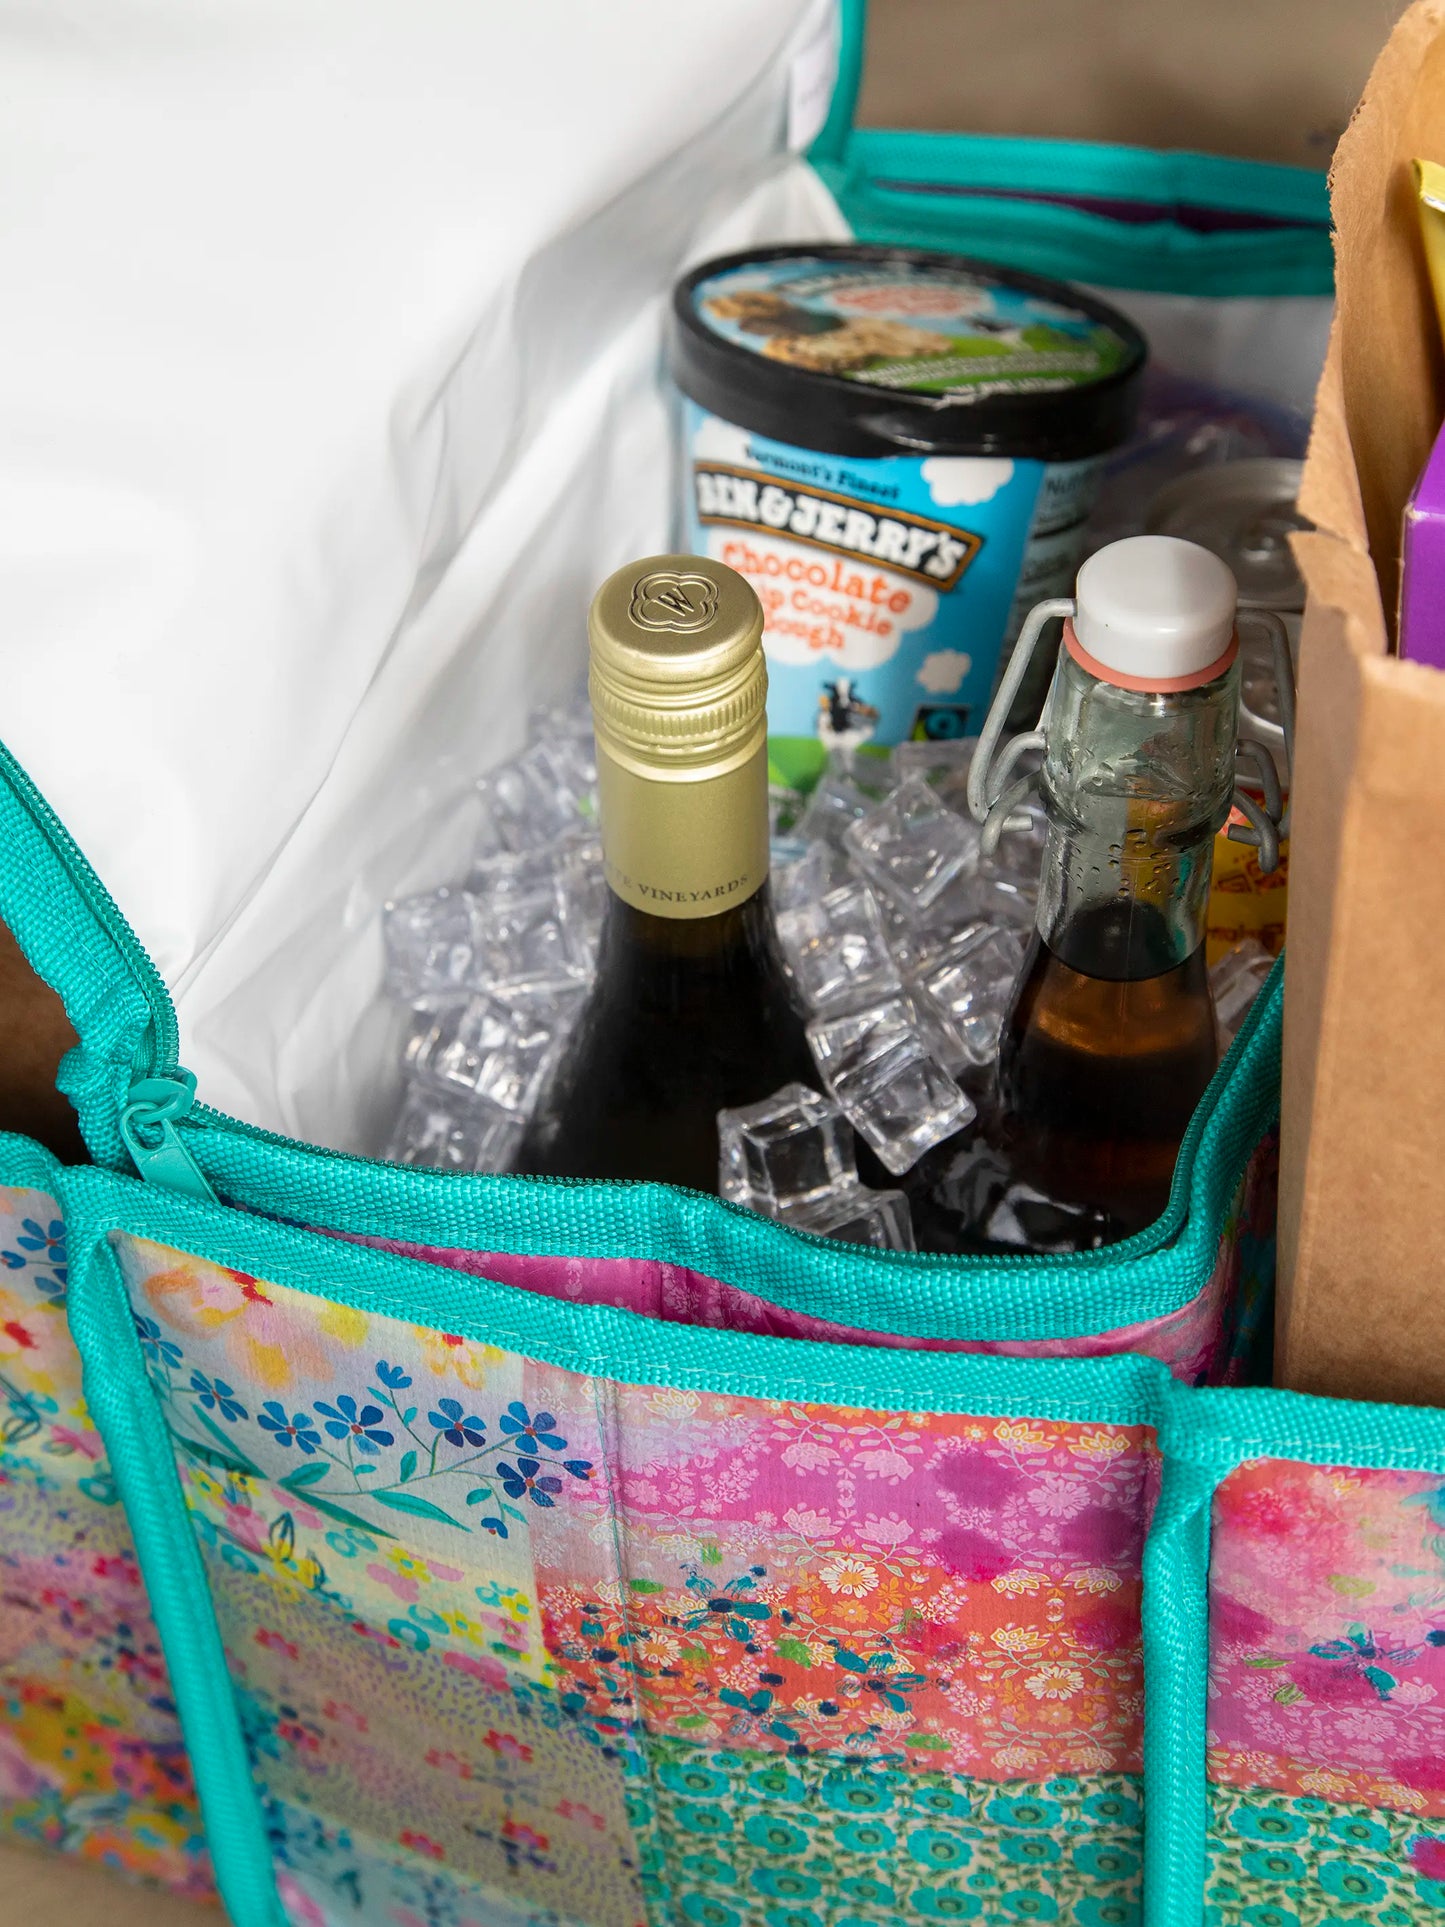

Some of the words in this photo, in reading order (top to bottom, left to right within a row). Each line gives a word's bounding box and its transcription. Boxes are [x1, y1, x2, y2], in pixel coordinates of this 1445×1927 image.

[722, 540, 911, 614] Chocolate
[790, 588, 894, 637] Cookie
[637, 873, 749, 902] VINEYARDS
